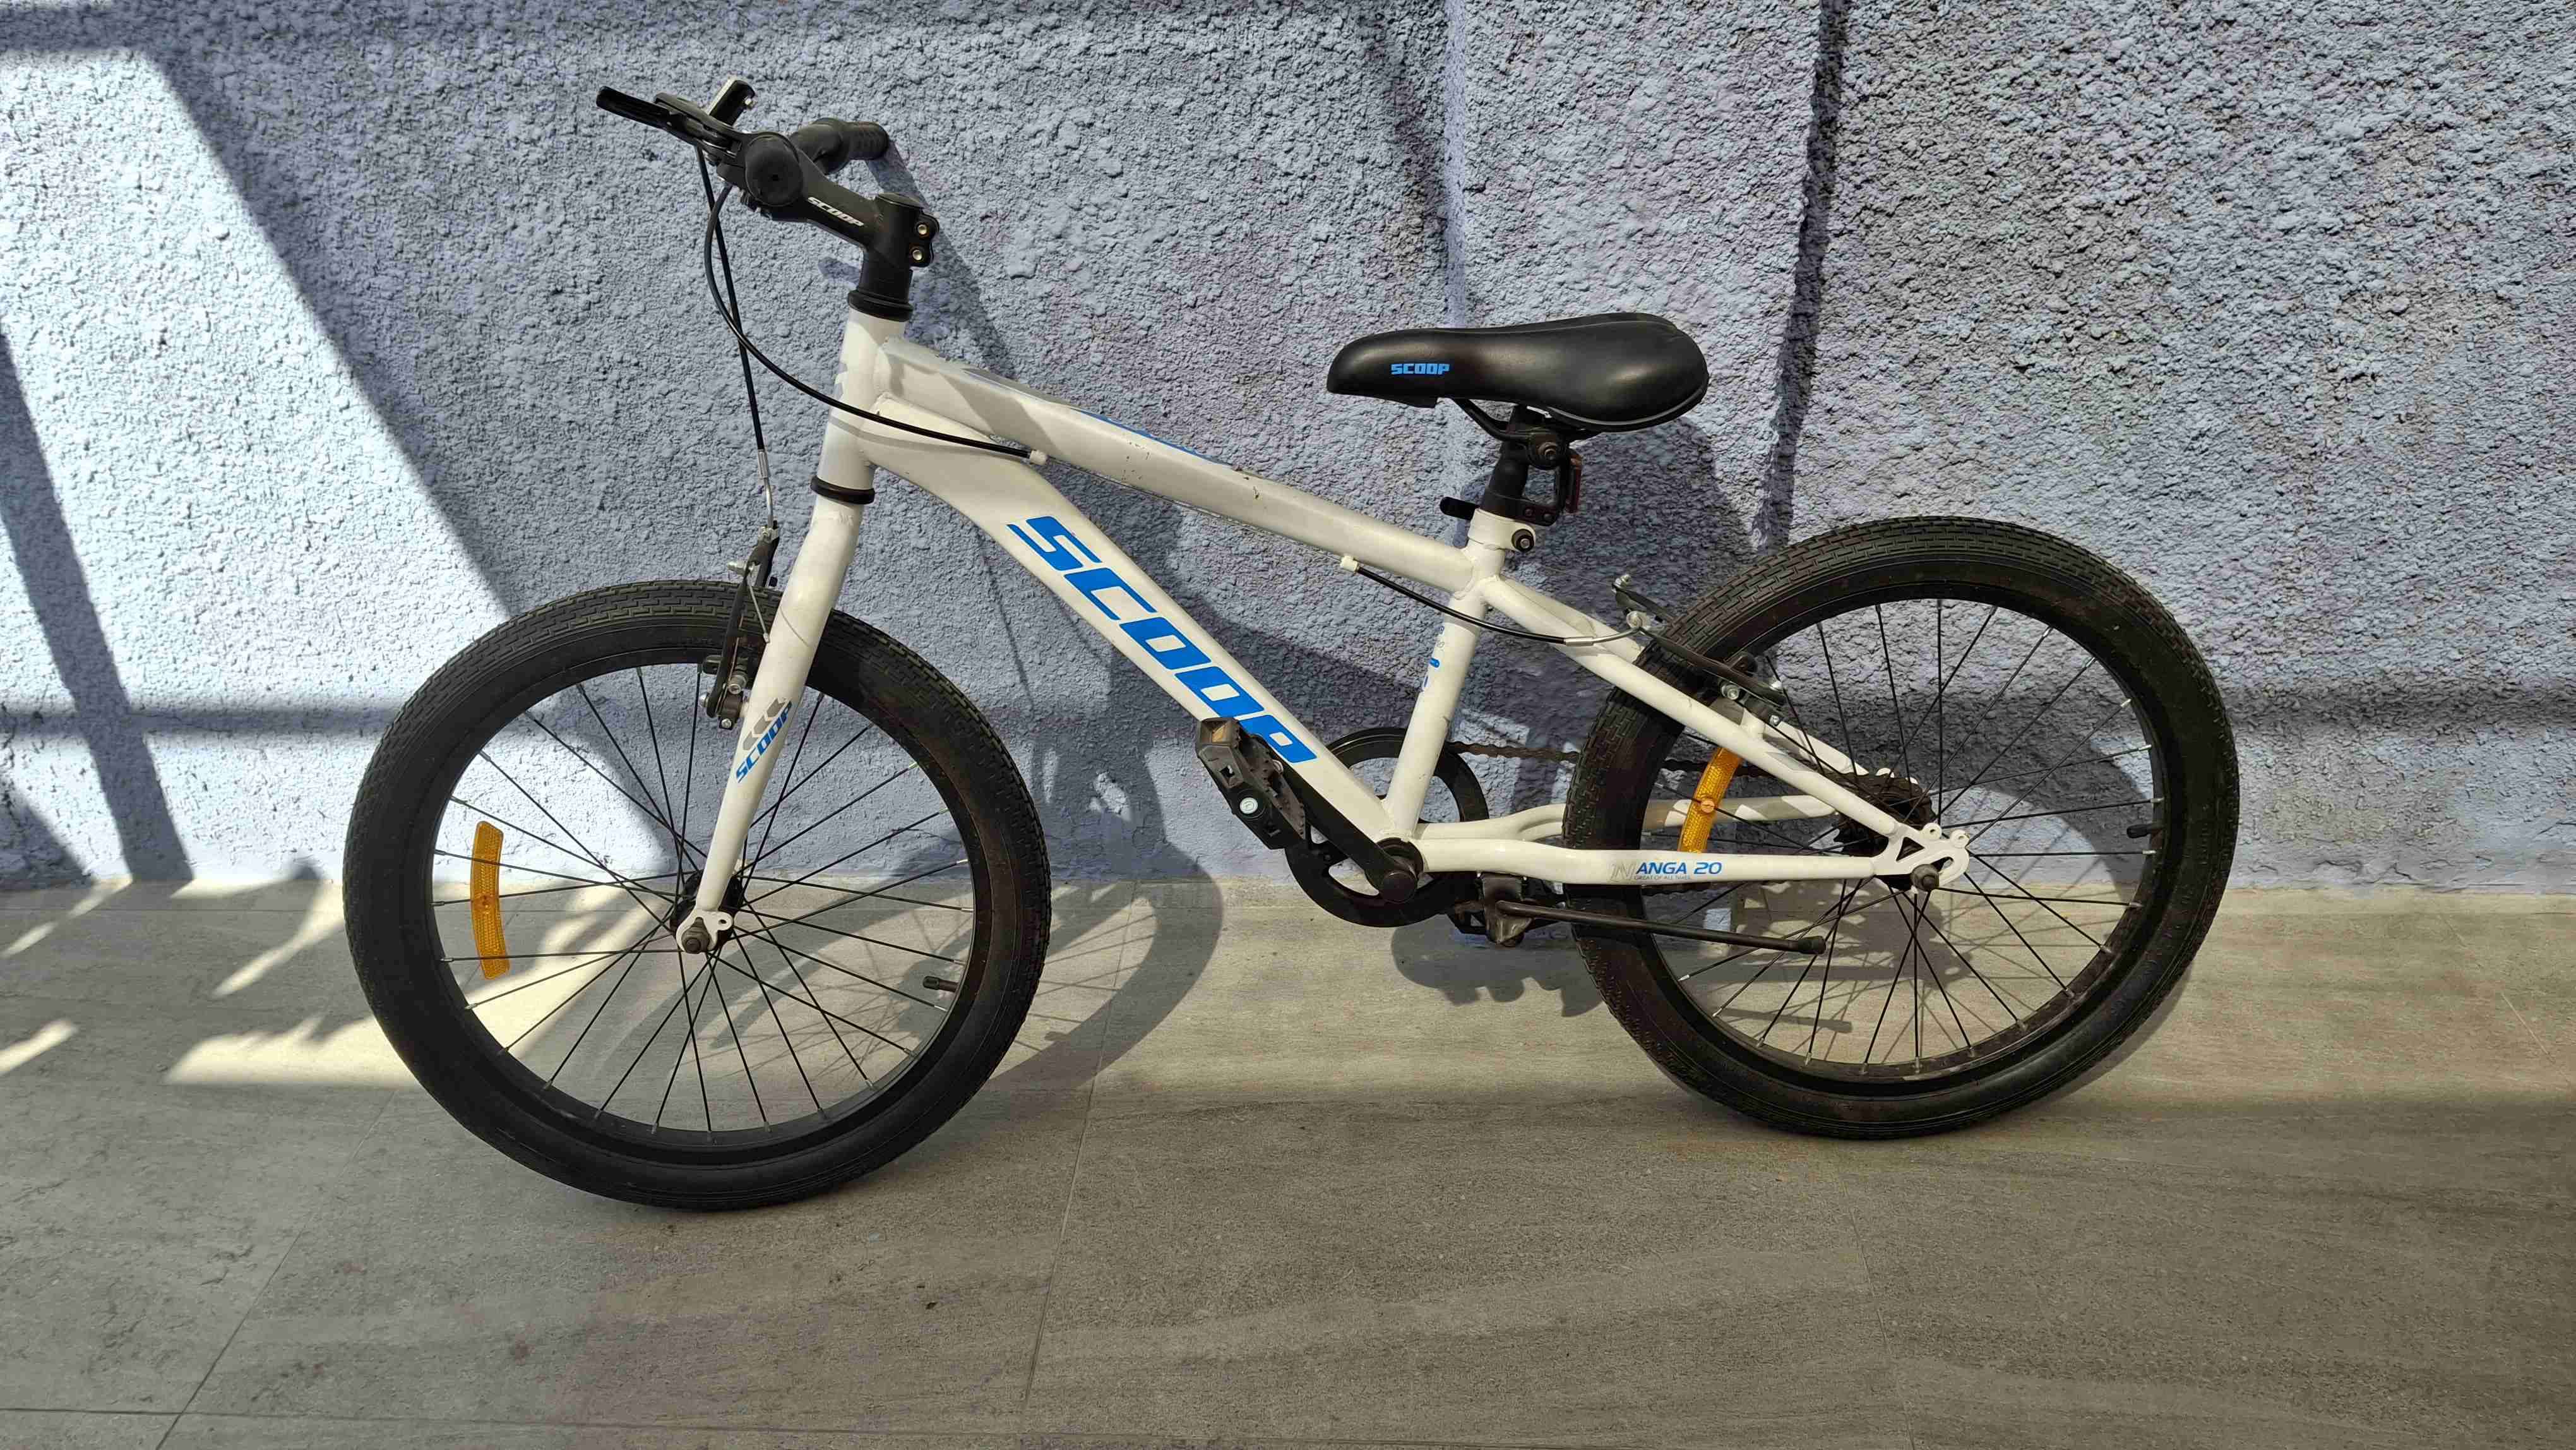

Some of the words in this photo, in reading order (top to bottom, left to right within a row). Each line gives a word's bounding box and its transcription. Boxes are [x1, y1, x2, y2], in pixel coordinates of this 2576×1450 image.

[808, 196, 864, 227] SCOOP
[1391, 363, 1450, 374] SCOOP
[1006, 515, 1318, 764] SCOOP
[736, 700, 792, 783] SCOOP
[1694, 861, 1722, 875] 20
